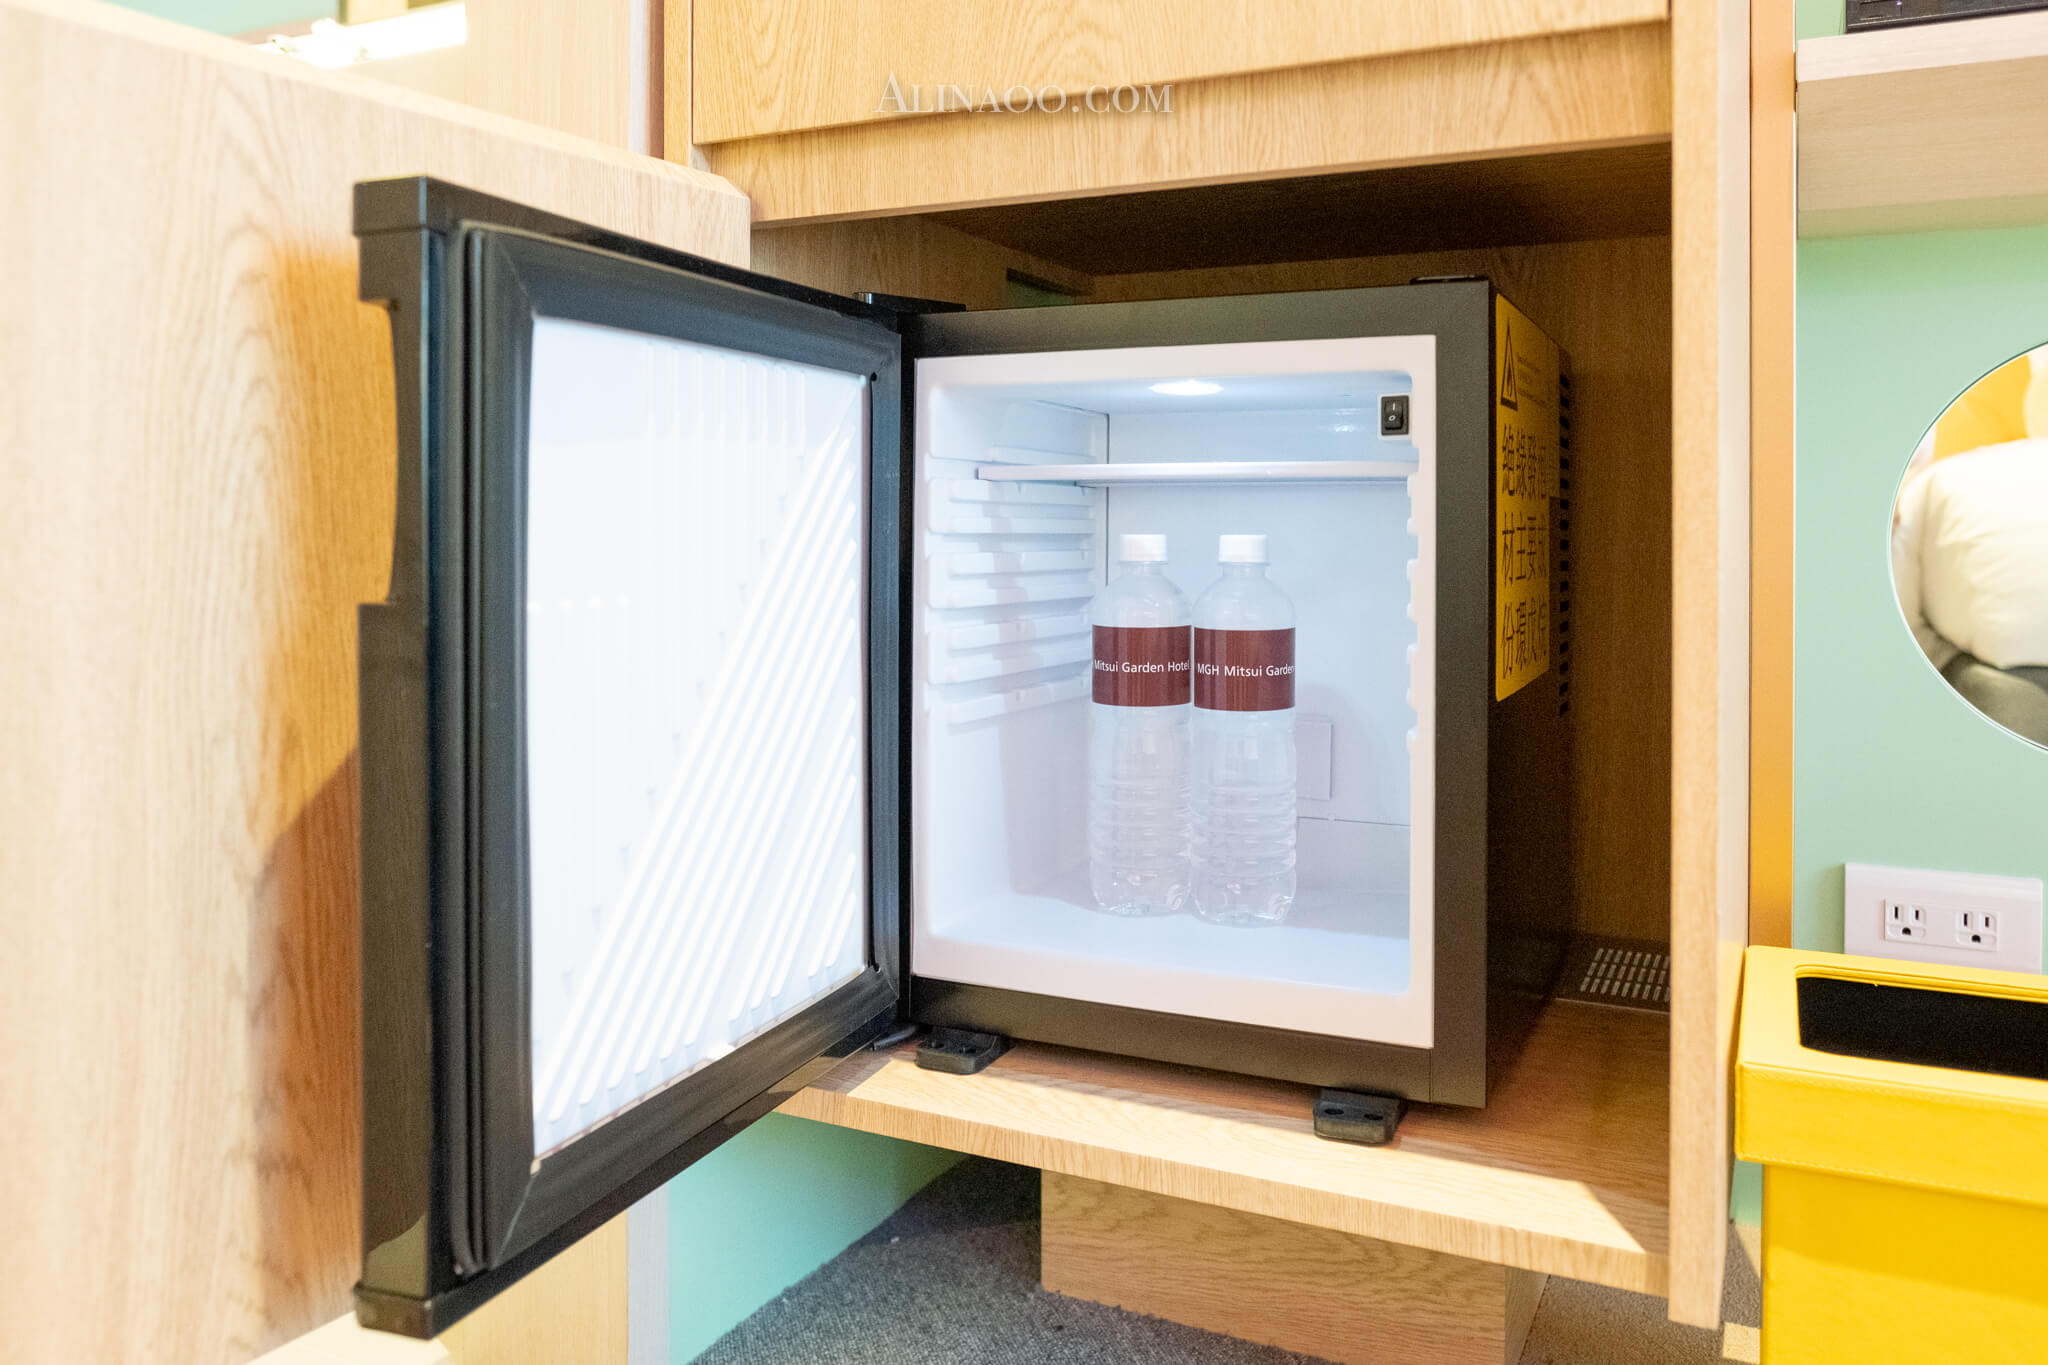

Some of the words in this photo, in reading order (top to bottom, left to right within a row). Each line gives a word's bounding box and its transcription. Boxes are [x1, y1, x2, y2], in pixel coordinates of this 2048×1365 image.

[1094, 659, 1118, 673] Mitsui
[1121, 661, 1165, 673] Garden
[1197, 663, 1220, 676] MGH
[1224, 665, 1263, 677] Mitsui
